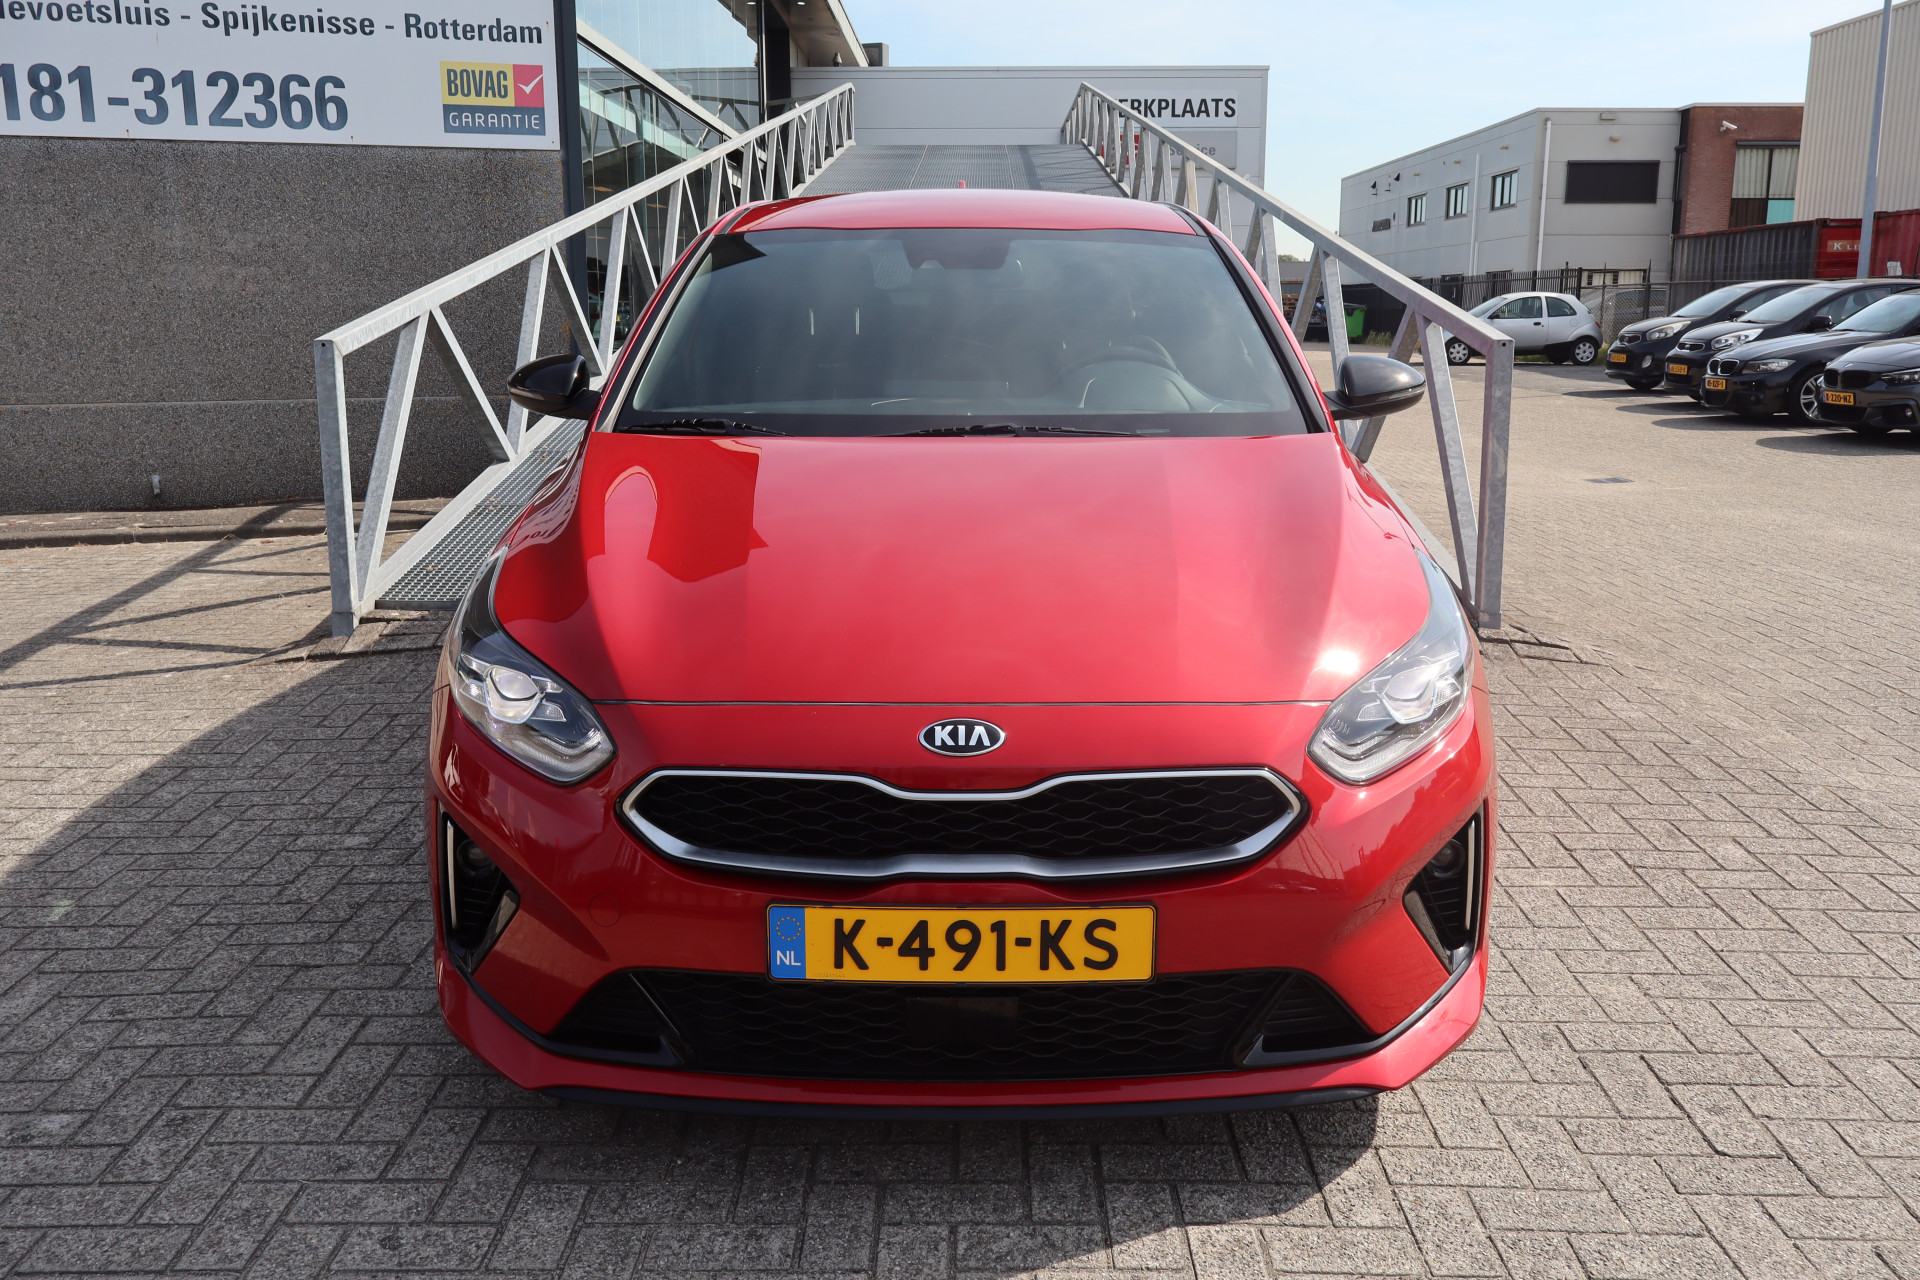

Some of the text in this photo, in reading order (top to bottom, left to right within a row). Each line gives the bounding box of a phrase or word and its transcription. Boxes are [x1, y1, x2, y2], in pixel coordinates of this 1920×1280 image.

[201, 2, 375, 37] Spijkenisse
[404, 12, 543, 45] Rotterdam
[0, 62, 349, 131] 181-312366
[446, 68, 509, 99] BOVAG
[449, 112, 540, 129] GARANTIE
[1098, 98, 1236, 118] ERKPLAATS
[934, 724, 991, 747] KIA
[776, 949, 802, 966] NL
[833, 918, 1119, 972] K-491-KS
